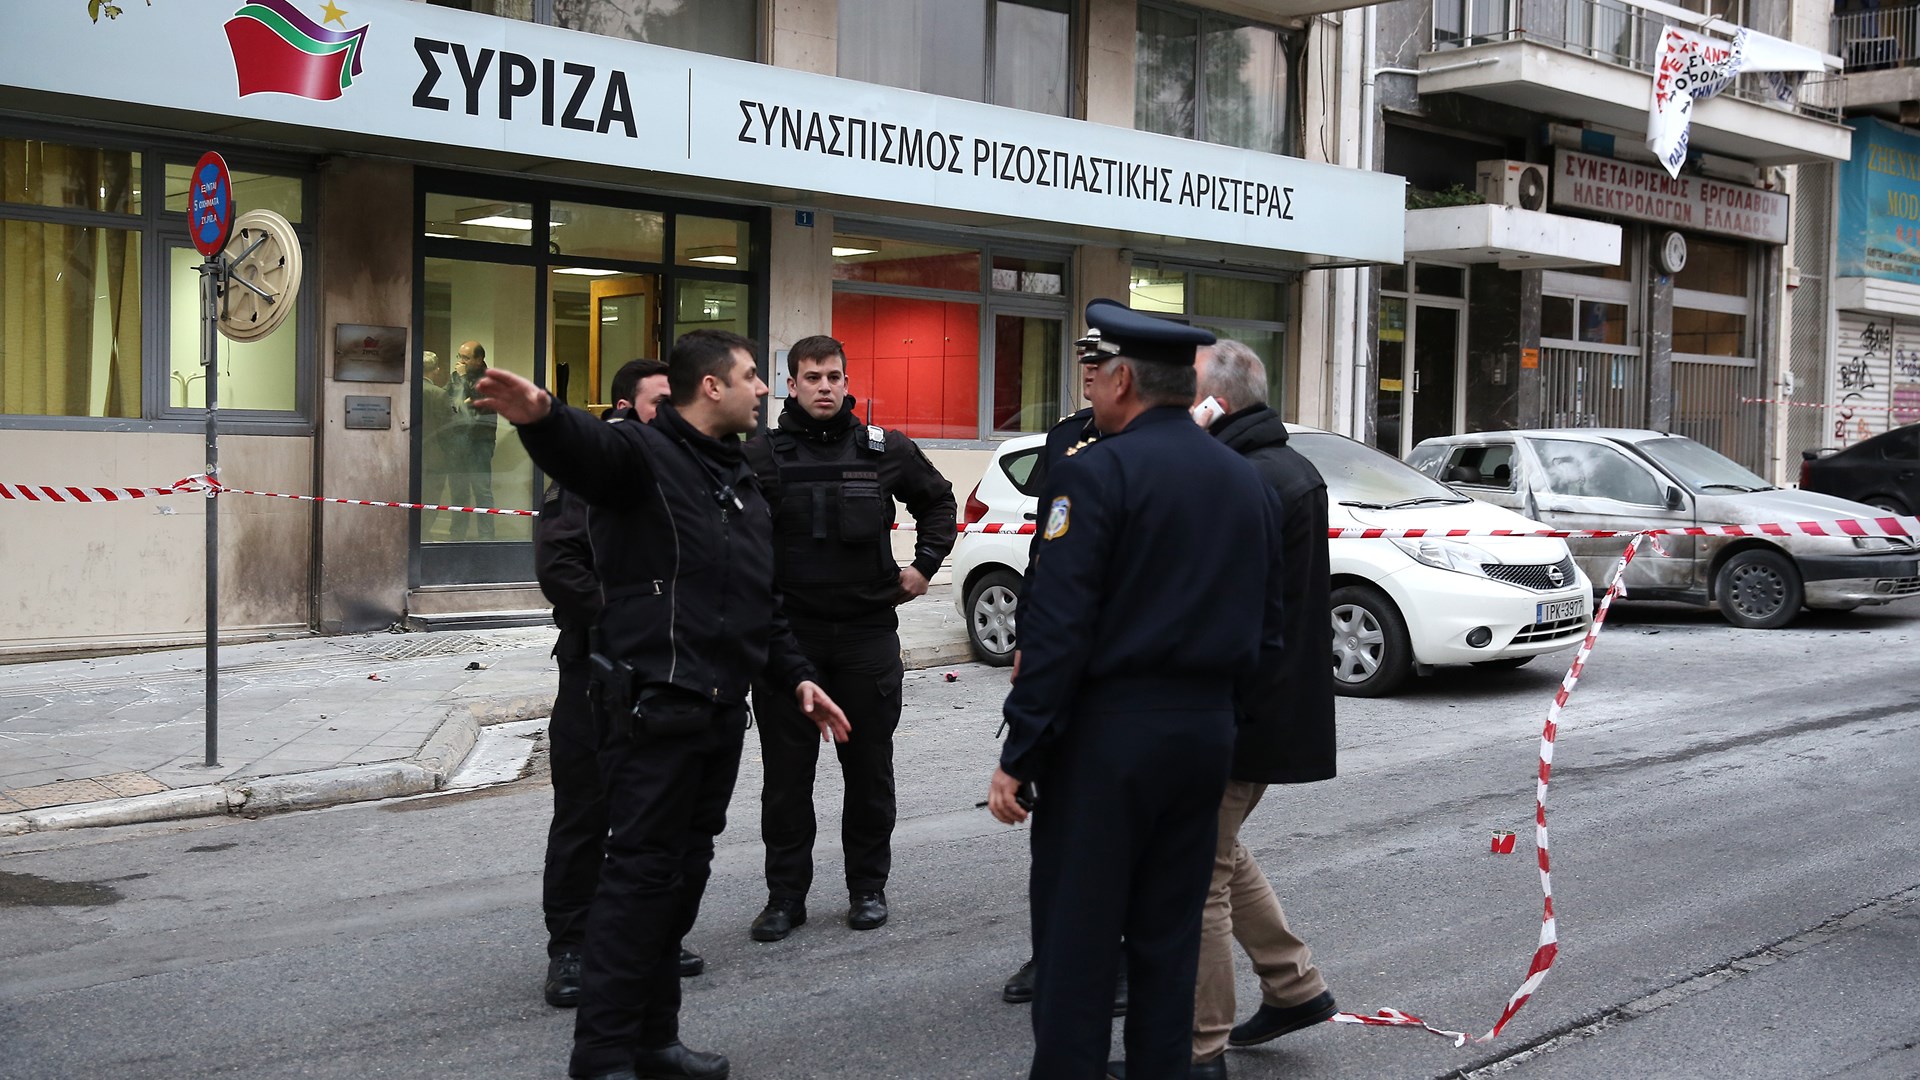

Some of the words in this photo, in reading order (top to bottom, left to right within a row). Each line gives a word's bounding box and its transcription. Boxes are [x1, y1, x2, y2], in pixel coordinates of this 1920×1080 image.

[412, 36, 638, 138] ΣΥΡΙΖΑ
[738, 100, 963, 174] ΣΥΝΑΣΠΙΣΜΟΣ
[973, 138, 1173, 204] ΡΙΖΟΣΠΑΣΤΙΚΗΣ
[1178, 172, 1295, 221] ΑΡΙΣΤΕΡΑΣ
[1565, 155, 1690, 199] ΣΥΝΕΤΑΙΡΙΣΜΟΣ
[1701, 183, 1779, 217] ΕΡΓΟΛΑΒΩΝ
[1573, 182, 1692, 223] ΗΛΕΚΤΡΟΛΟΓΩΝ
[1704, 206, 1771, 236] ΕΛΛΑΔΟΣ
[1888, 188, 1920, 221] MOD
